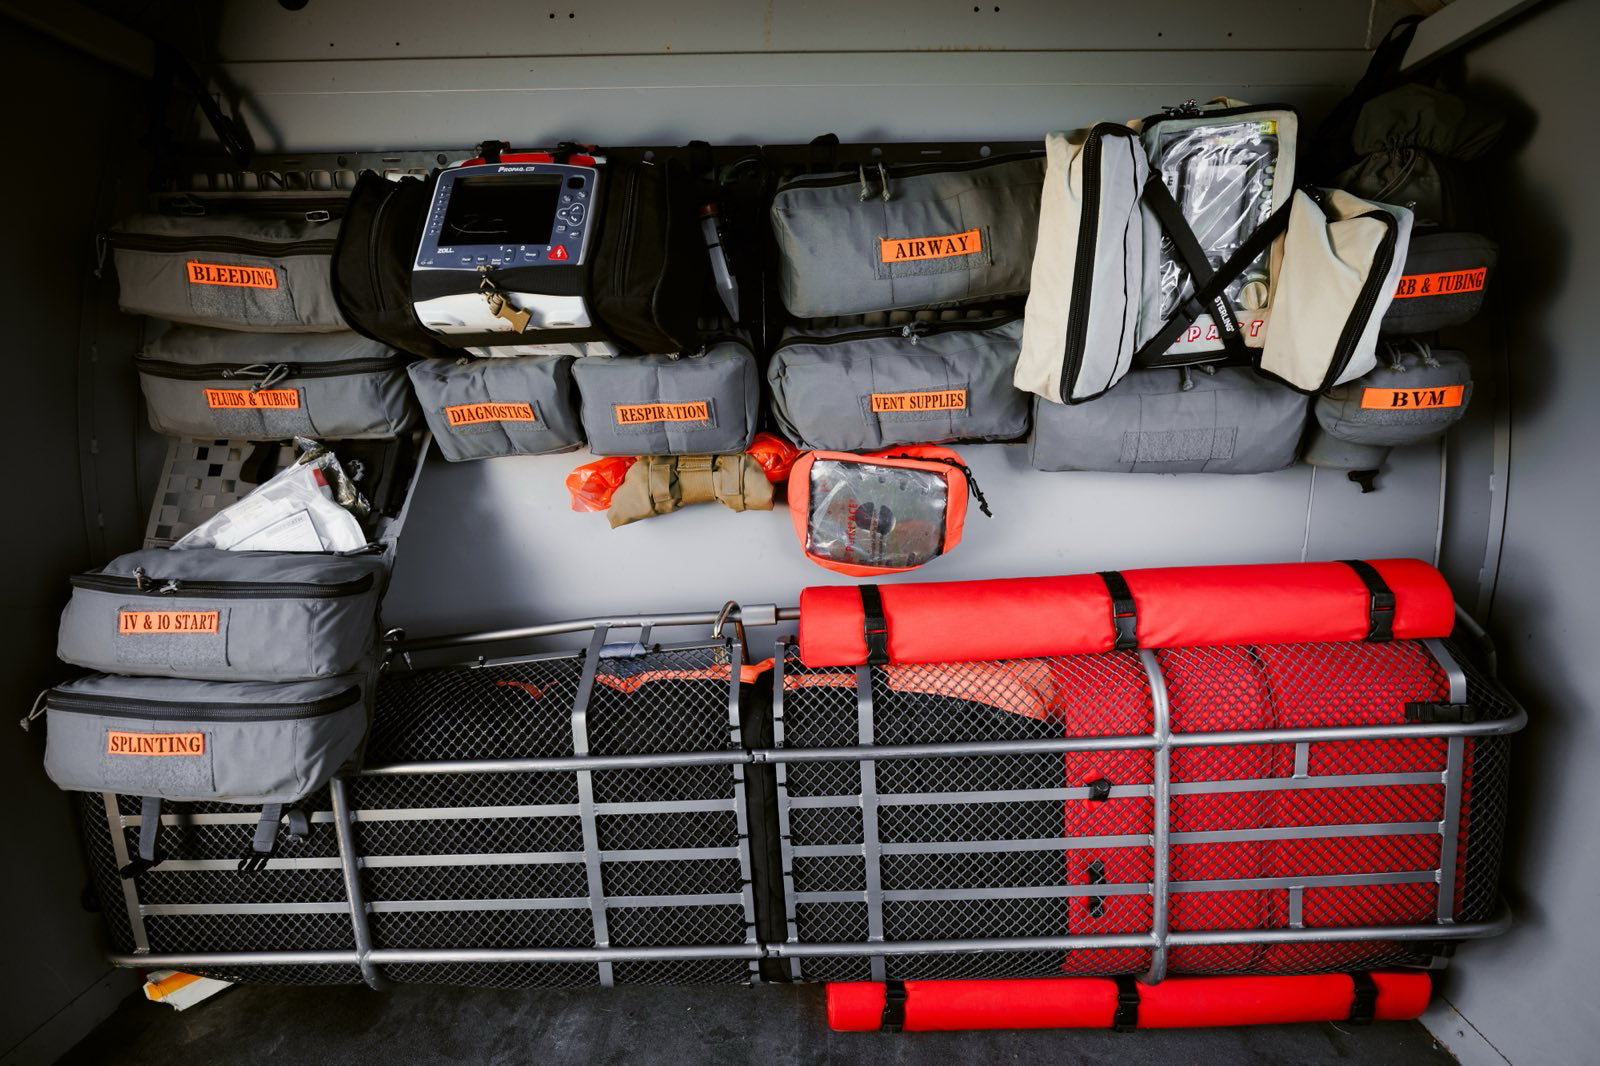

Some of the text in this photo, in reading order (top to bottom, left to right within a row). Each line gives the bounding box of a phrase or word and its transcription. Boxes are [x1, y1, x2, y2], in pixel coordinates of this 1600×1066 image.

[895, 235, 968, 259] AIRWAY
[192, 266, 273, 286] BLEEDING
[1421, 277, 1430, 294] &
[1437, 271, 1484, 293] TUBING
[210, 392, 296, 406] FLUIDS & TUBING
[874, 393, 964, 410] VENT SUPPLIES
[1391, 390, 1446, 407] BVM
[451, 405, 532, 423] DIAGNOSTICS
[620, 405, 706, 422] RESPIRATION
[124, 614, 215, 630] IV & IO START
[111, 735, 201, 753] SPLINTING
